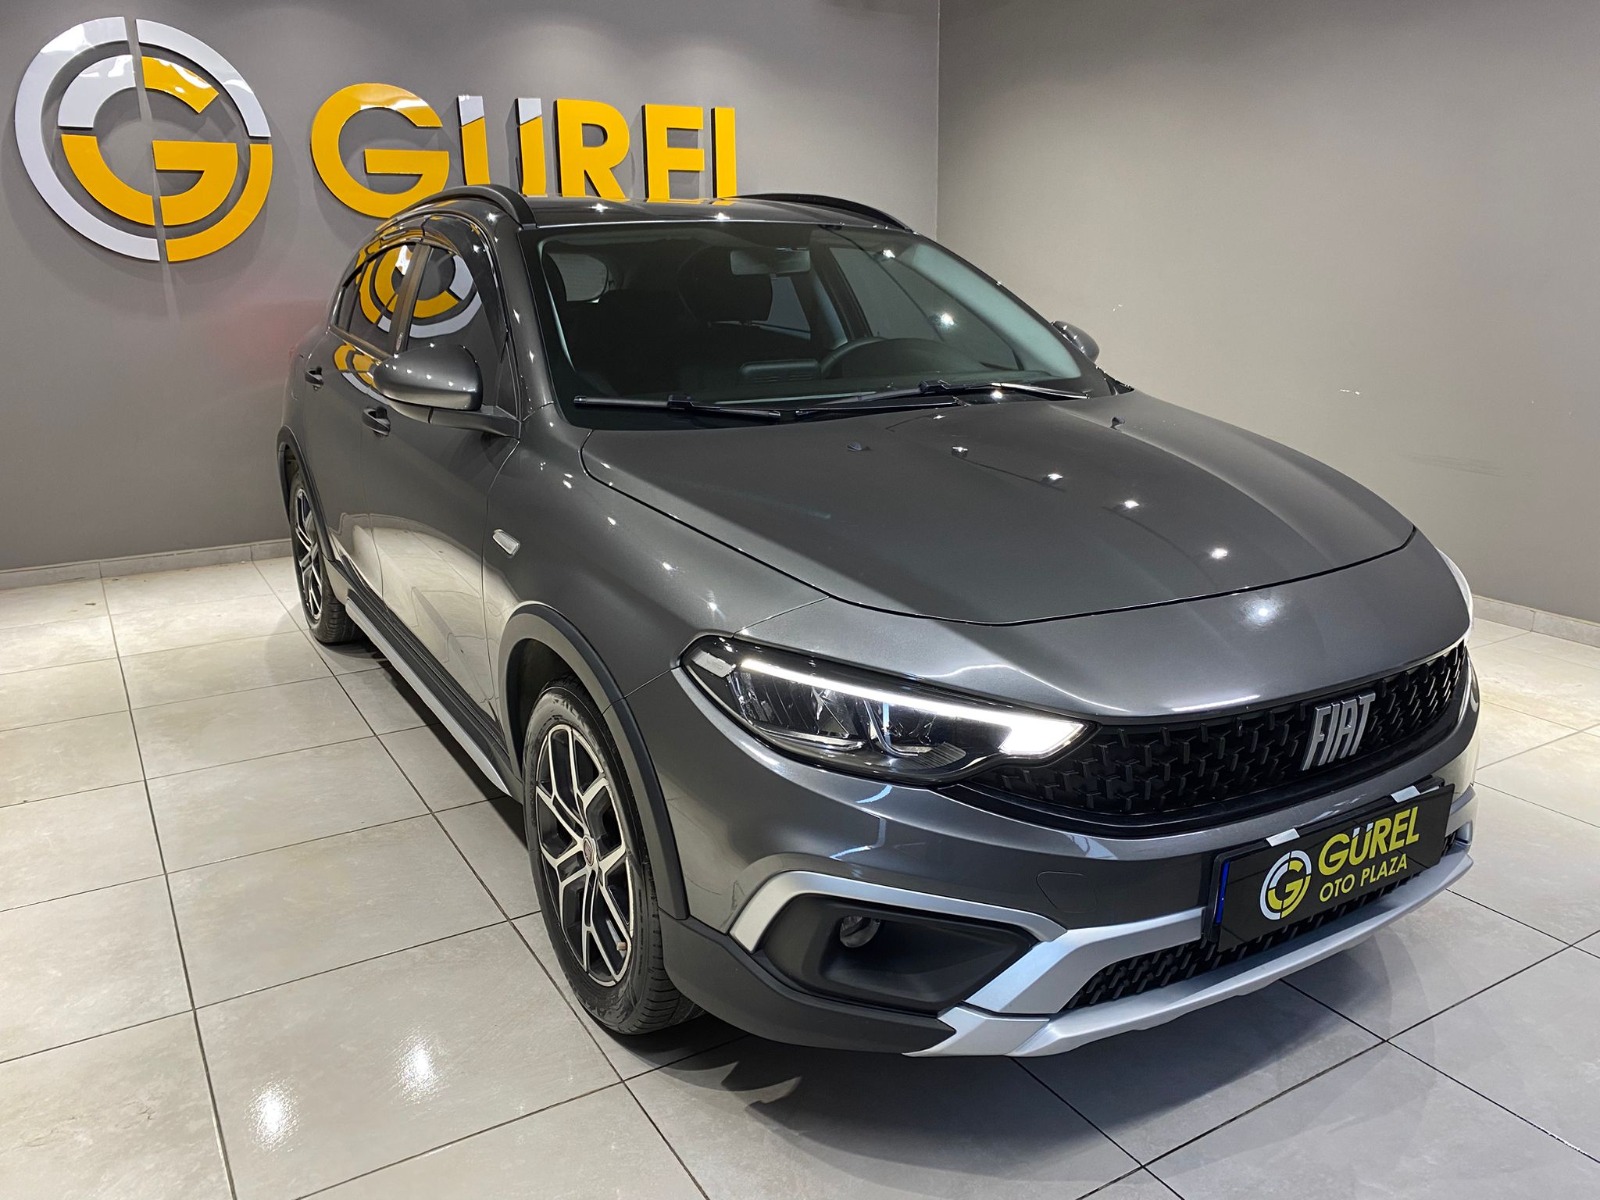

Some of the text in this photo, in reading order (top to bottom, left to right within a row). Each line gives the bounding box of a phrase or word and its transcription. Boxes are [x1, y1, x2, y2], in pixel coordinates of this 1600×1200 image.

[1302, 692, 1376, 771] FIAT
[1318, 806, 1420, 876] GÜREL
[1319, 853, 1408, 903] OTO PLAZA
